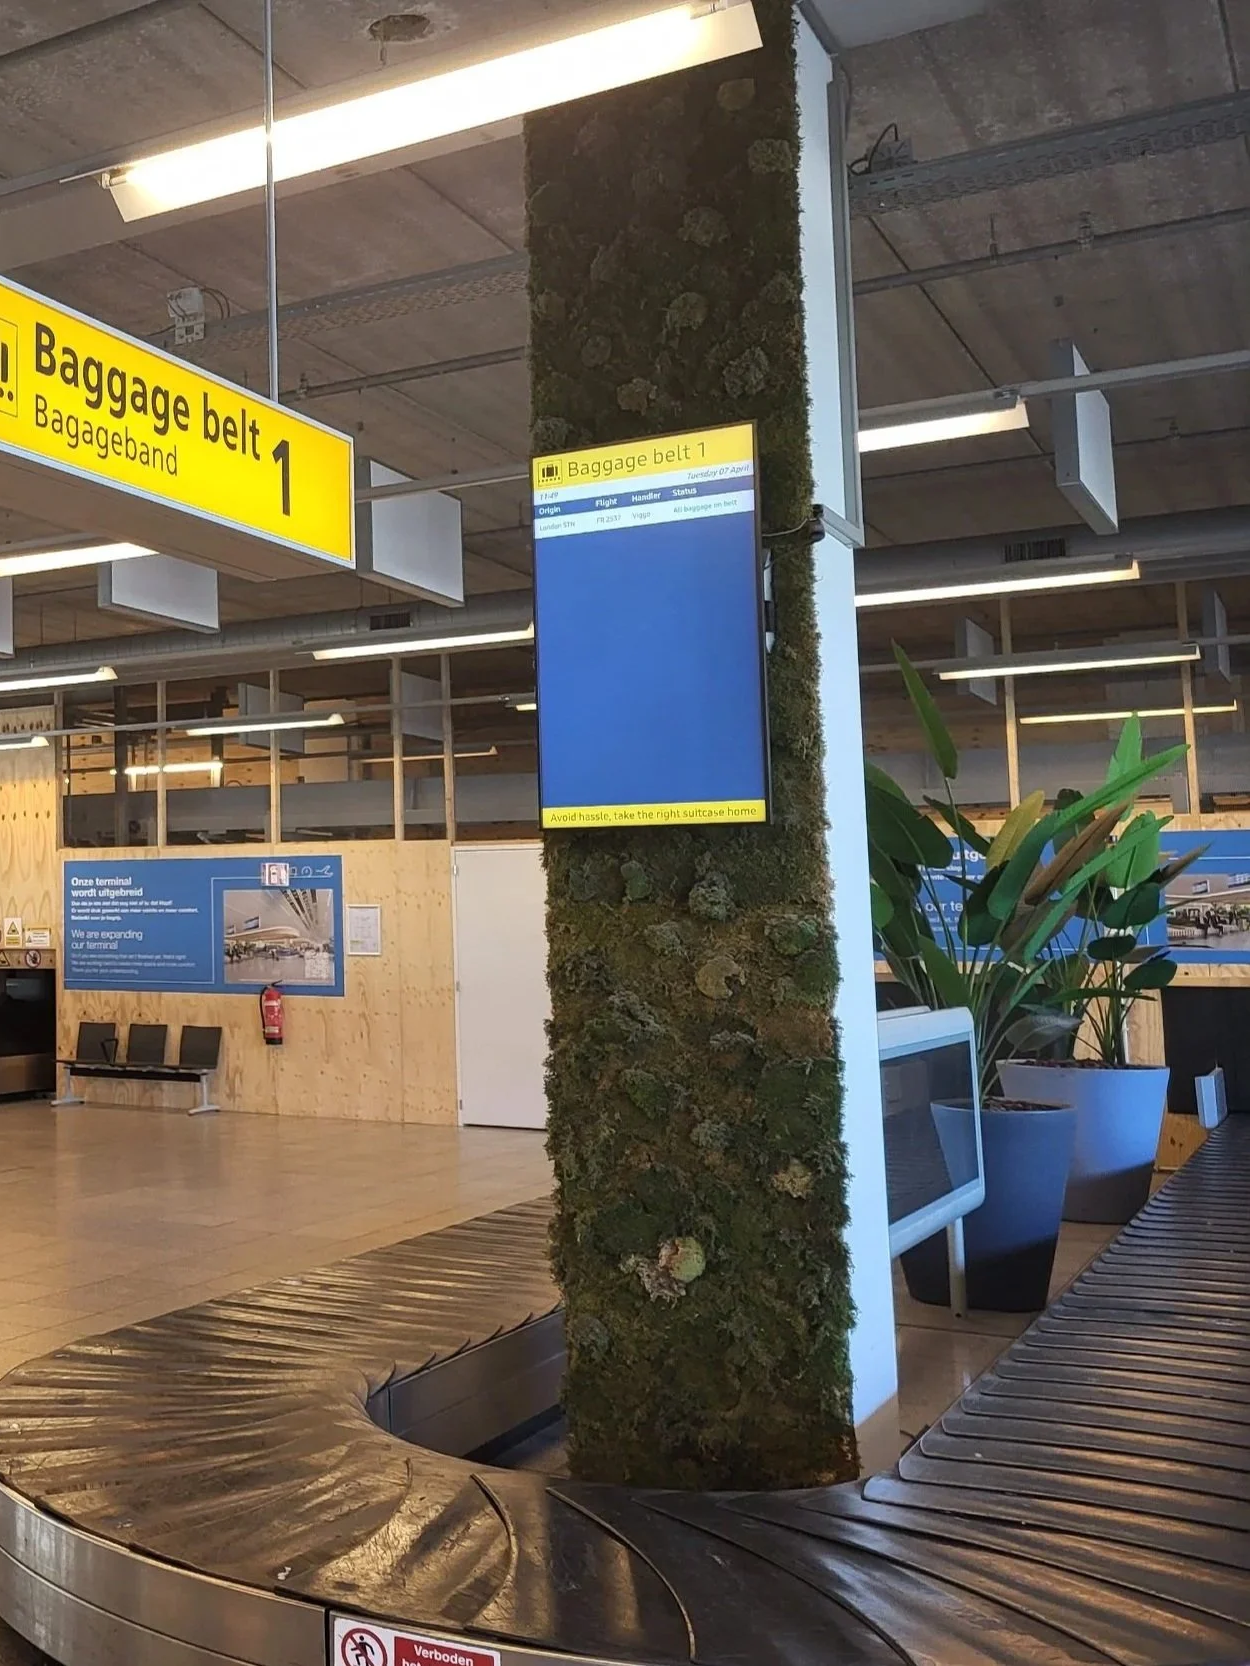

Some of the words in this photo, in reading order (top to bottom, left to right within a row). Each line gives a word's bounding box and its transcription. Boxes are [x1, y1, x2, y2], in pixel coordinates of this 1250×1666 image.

[35, 322, 190, 437] Baggage
[203, 391, 261, 461] belt
[272, 438, 291, 518] 1
[35, 393, 178, 477] Bagageband
[567, 455, 648, 479] Baggage
[653, 445, 691, 465] belt
[697, 441, 706, 458] 1
[687, 469, 718, 480] Tuesday
[718, 467, 729, 475] 07
[730, 464, 750, 474] April
[631, 491, 662, 504] Handler
[671, 487, 698, 497] Status
[595, 498, 618, 508] Flight
[684, 503, 712, 513] baggage
[724, 499, 738, 507] belt
[538, 506, 561, 516] Origin
[596, 516, 605, 524] FR
[539, 522, 561, 532] London
[550, 812, 577, 823] Avoid
[578, 811, 612, 823] hassle,
[614, 810, 636, 821] take
[637, 810, 654, 820] the
[656, 808, 681, 822] right
[682, 807, 725, 819] suitcase
[727, 806, 757, 818] home
[71, 877, 95, 887] Onze
[95, 876, 132, 887] terminal
[70, 888, 97, 898] wordt
[98, 887, 144, 899] uitgebreid
[71, 929, 85, 939] We
[85, 931, 99, 939] are
[100, 929, 143, 941] expanding
[71, 942, 85, 950] our
[86, 940, 119, 950] terminal
[413, 1644, 474, 1666] Verboden
